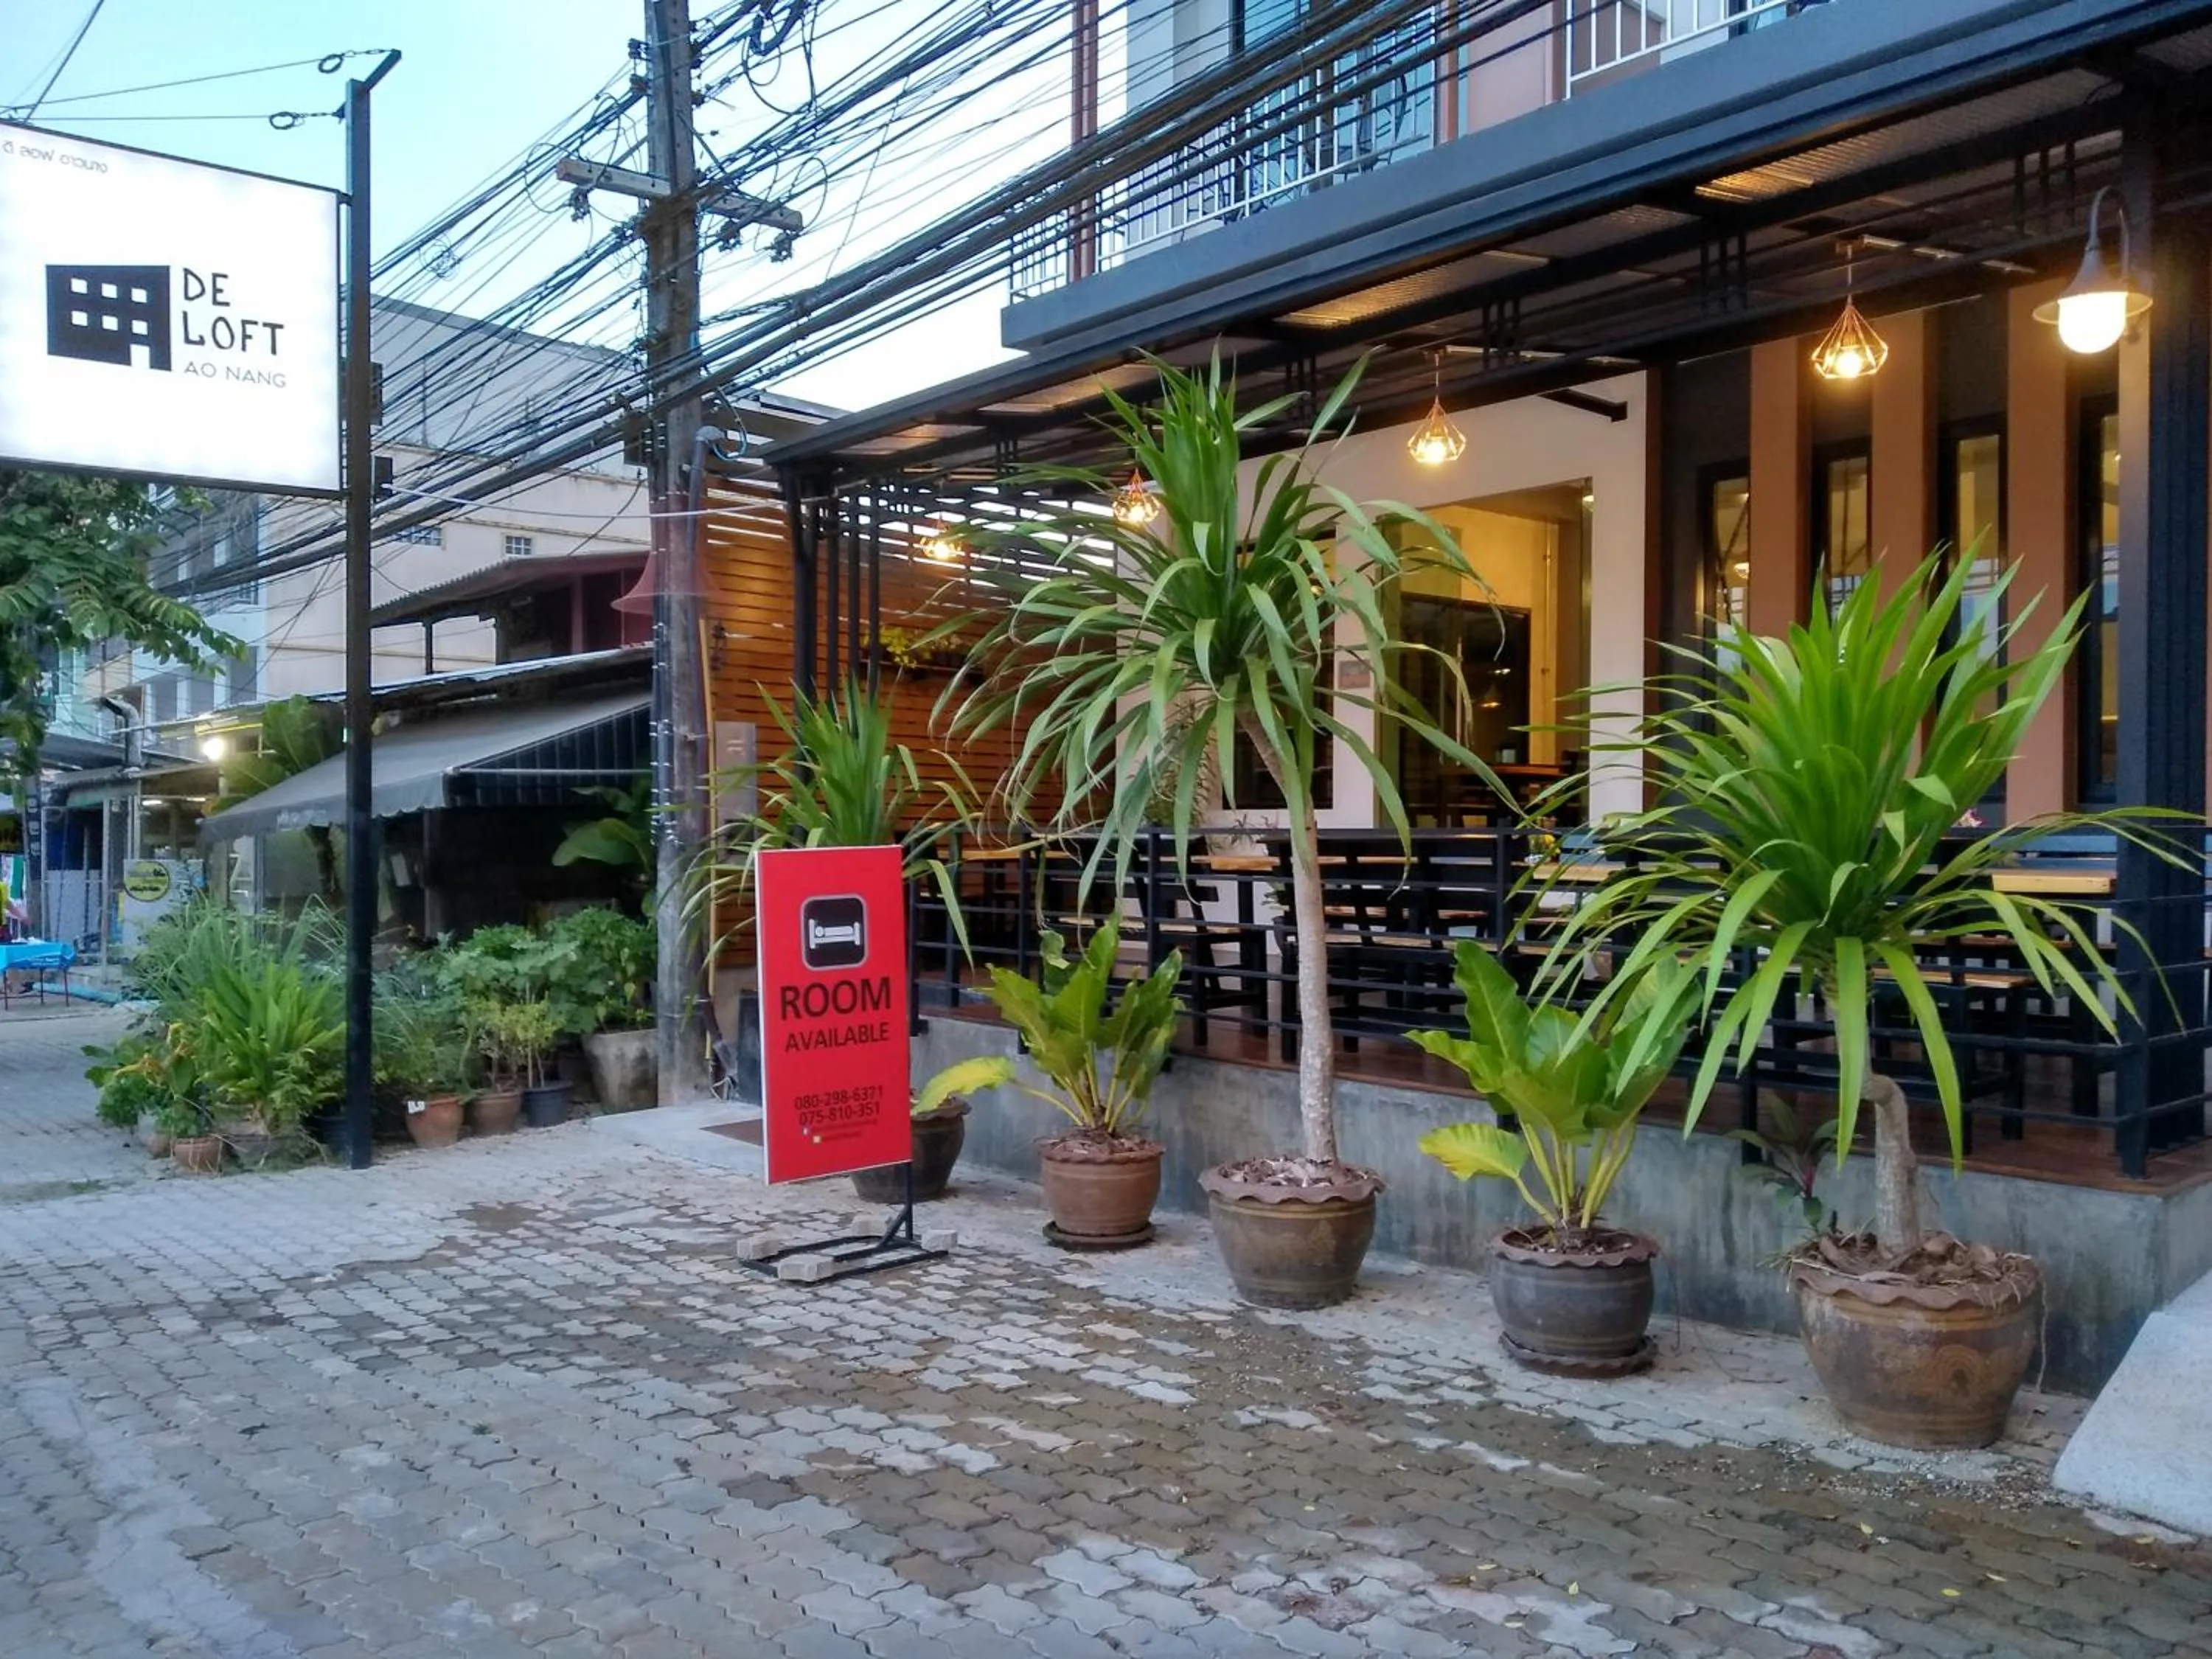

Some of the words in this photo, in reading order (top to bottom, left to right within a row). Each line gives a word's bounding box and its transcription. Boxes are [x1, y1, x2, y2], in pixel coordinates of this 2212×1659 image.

[183, 267, 231, 307] DE
[183, 310, 284, 355] LOFT
[184, 361, 218, 378] AO
[226, 366, 287, 389] NANG
[779, 976, 891, 1021] ROOM
[785, 1022, 890, 1053] AVAILABLE
